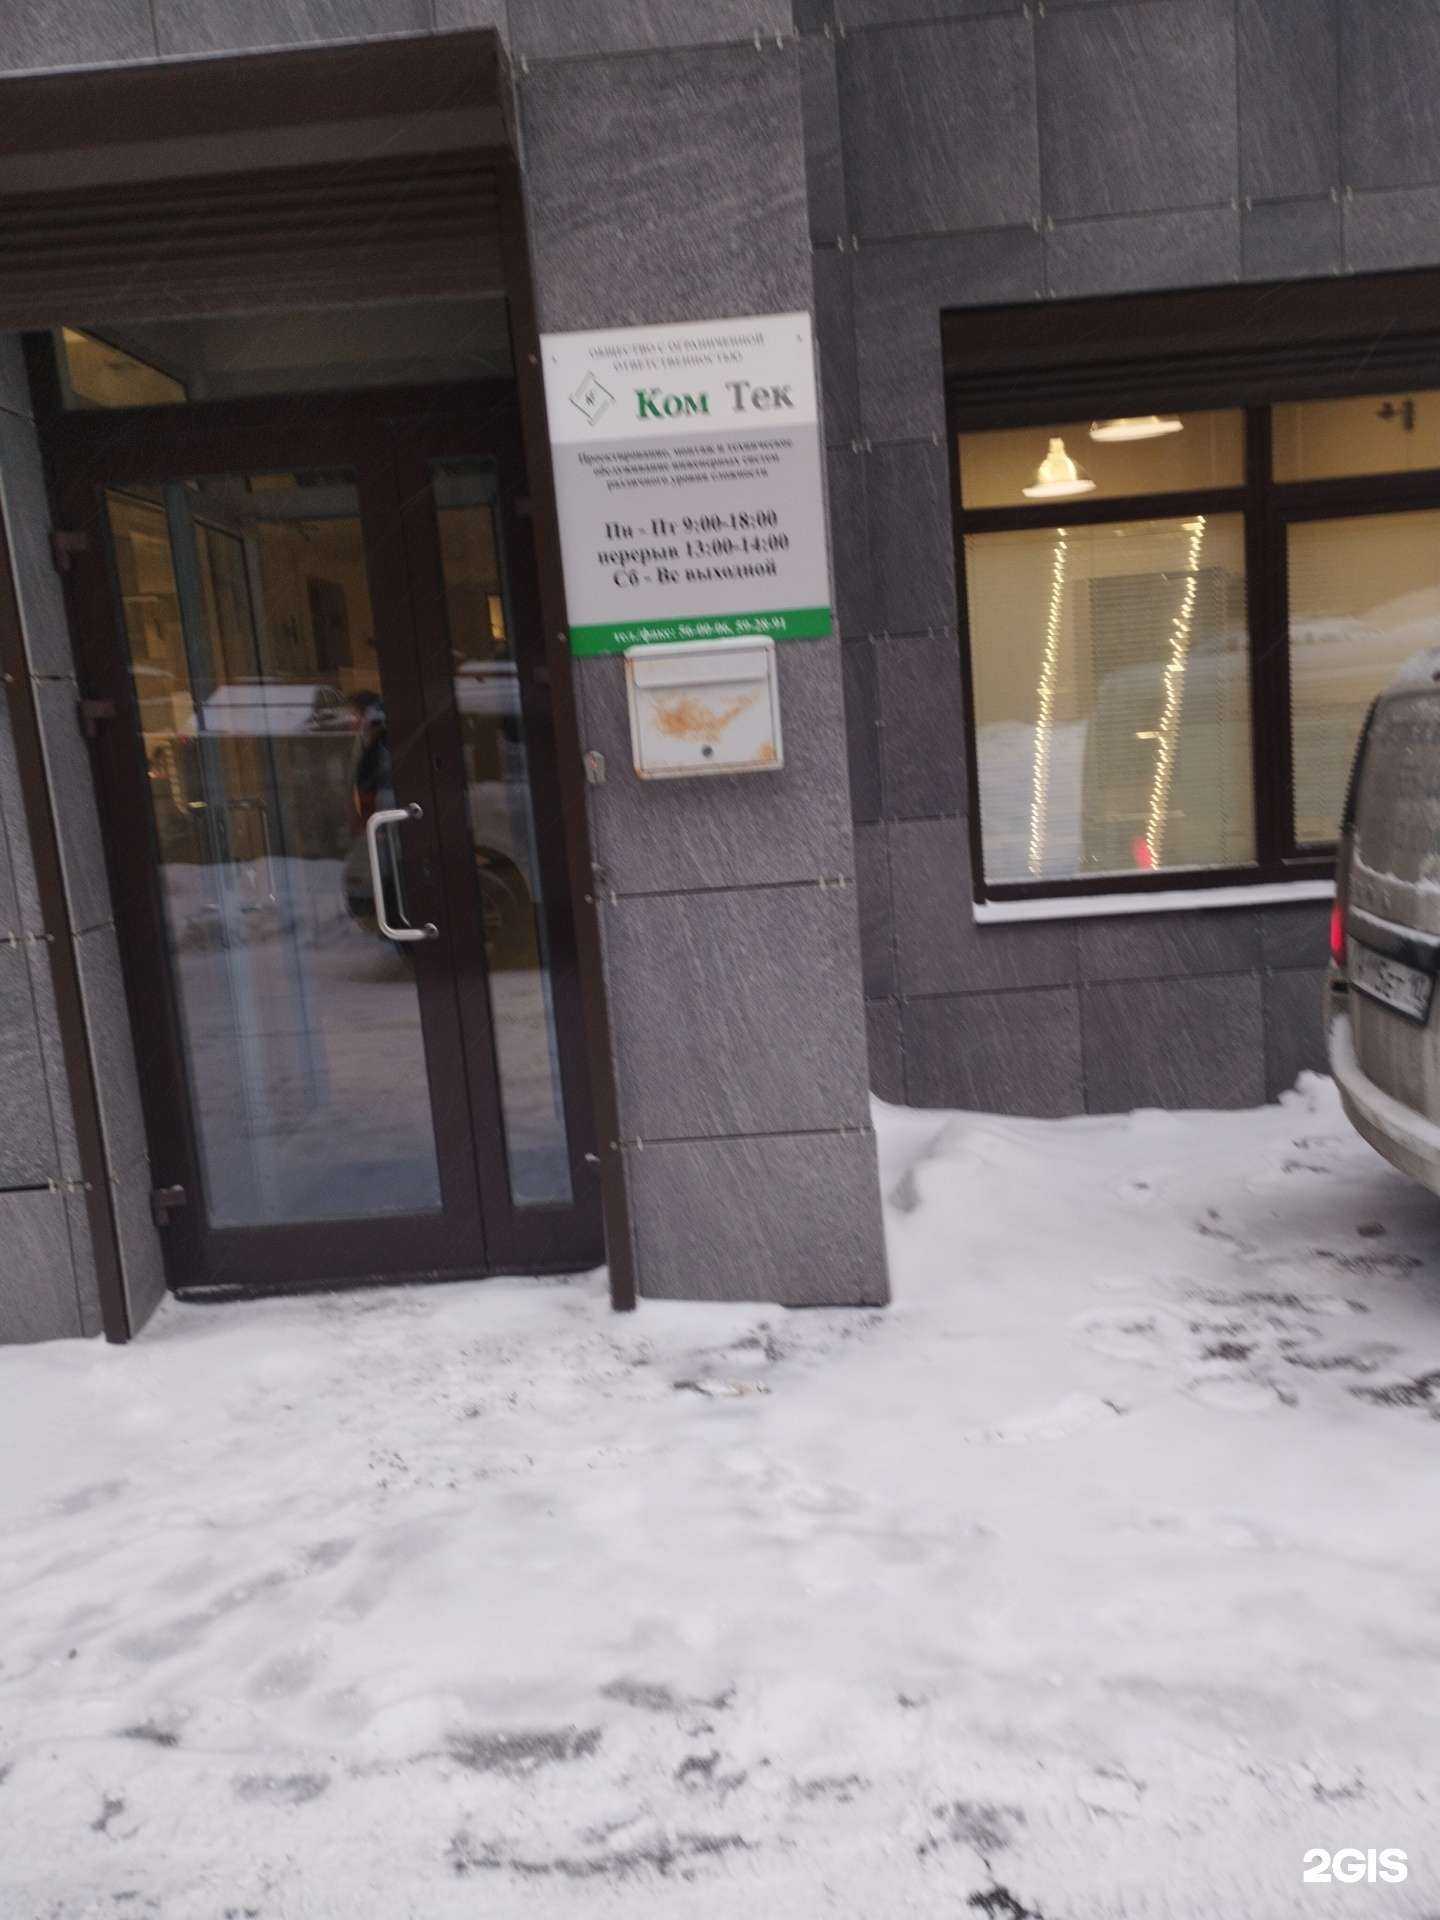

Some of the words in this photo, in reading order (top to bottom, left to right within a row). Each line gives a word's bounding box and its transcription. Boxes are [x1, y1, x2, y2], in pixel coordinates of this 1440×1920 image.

[634, 386, 711, 420] Ком
[724, 379, 795, 413] Тек
[604, 521, 634, 540] Пн
[650, 516, 680, 537] Пт
[681, 509, 778, 533] 9:00-18:00
[597, 545, 680, 567] перерыв
[685, 532, 790, 558] 13:00-14:00
[612, 568, 640, 589] Сб
[656, 566, 680, 585] Вс
[684, 557, 778, 583] выходной
